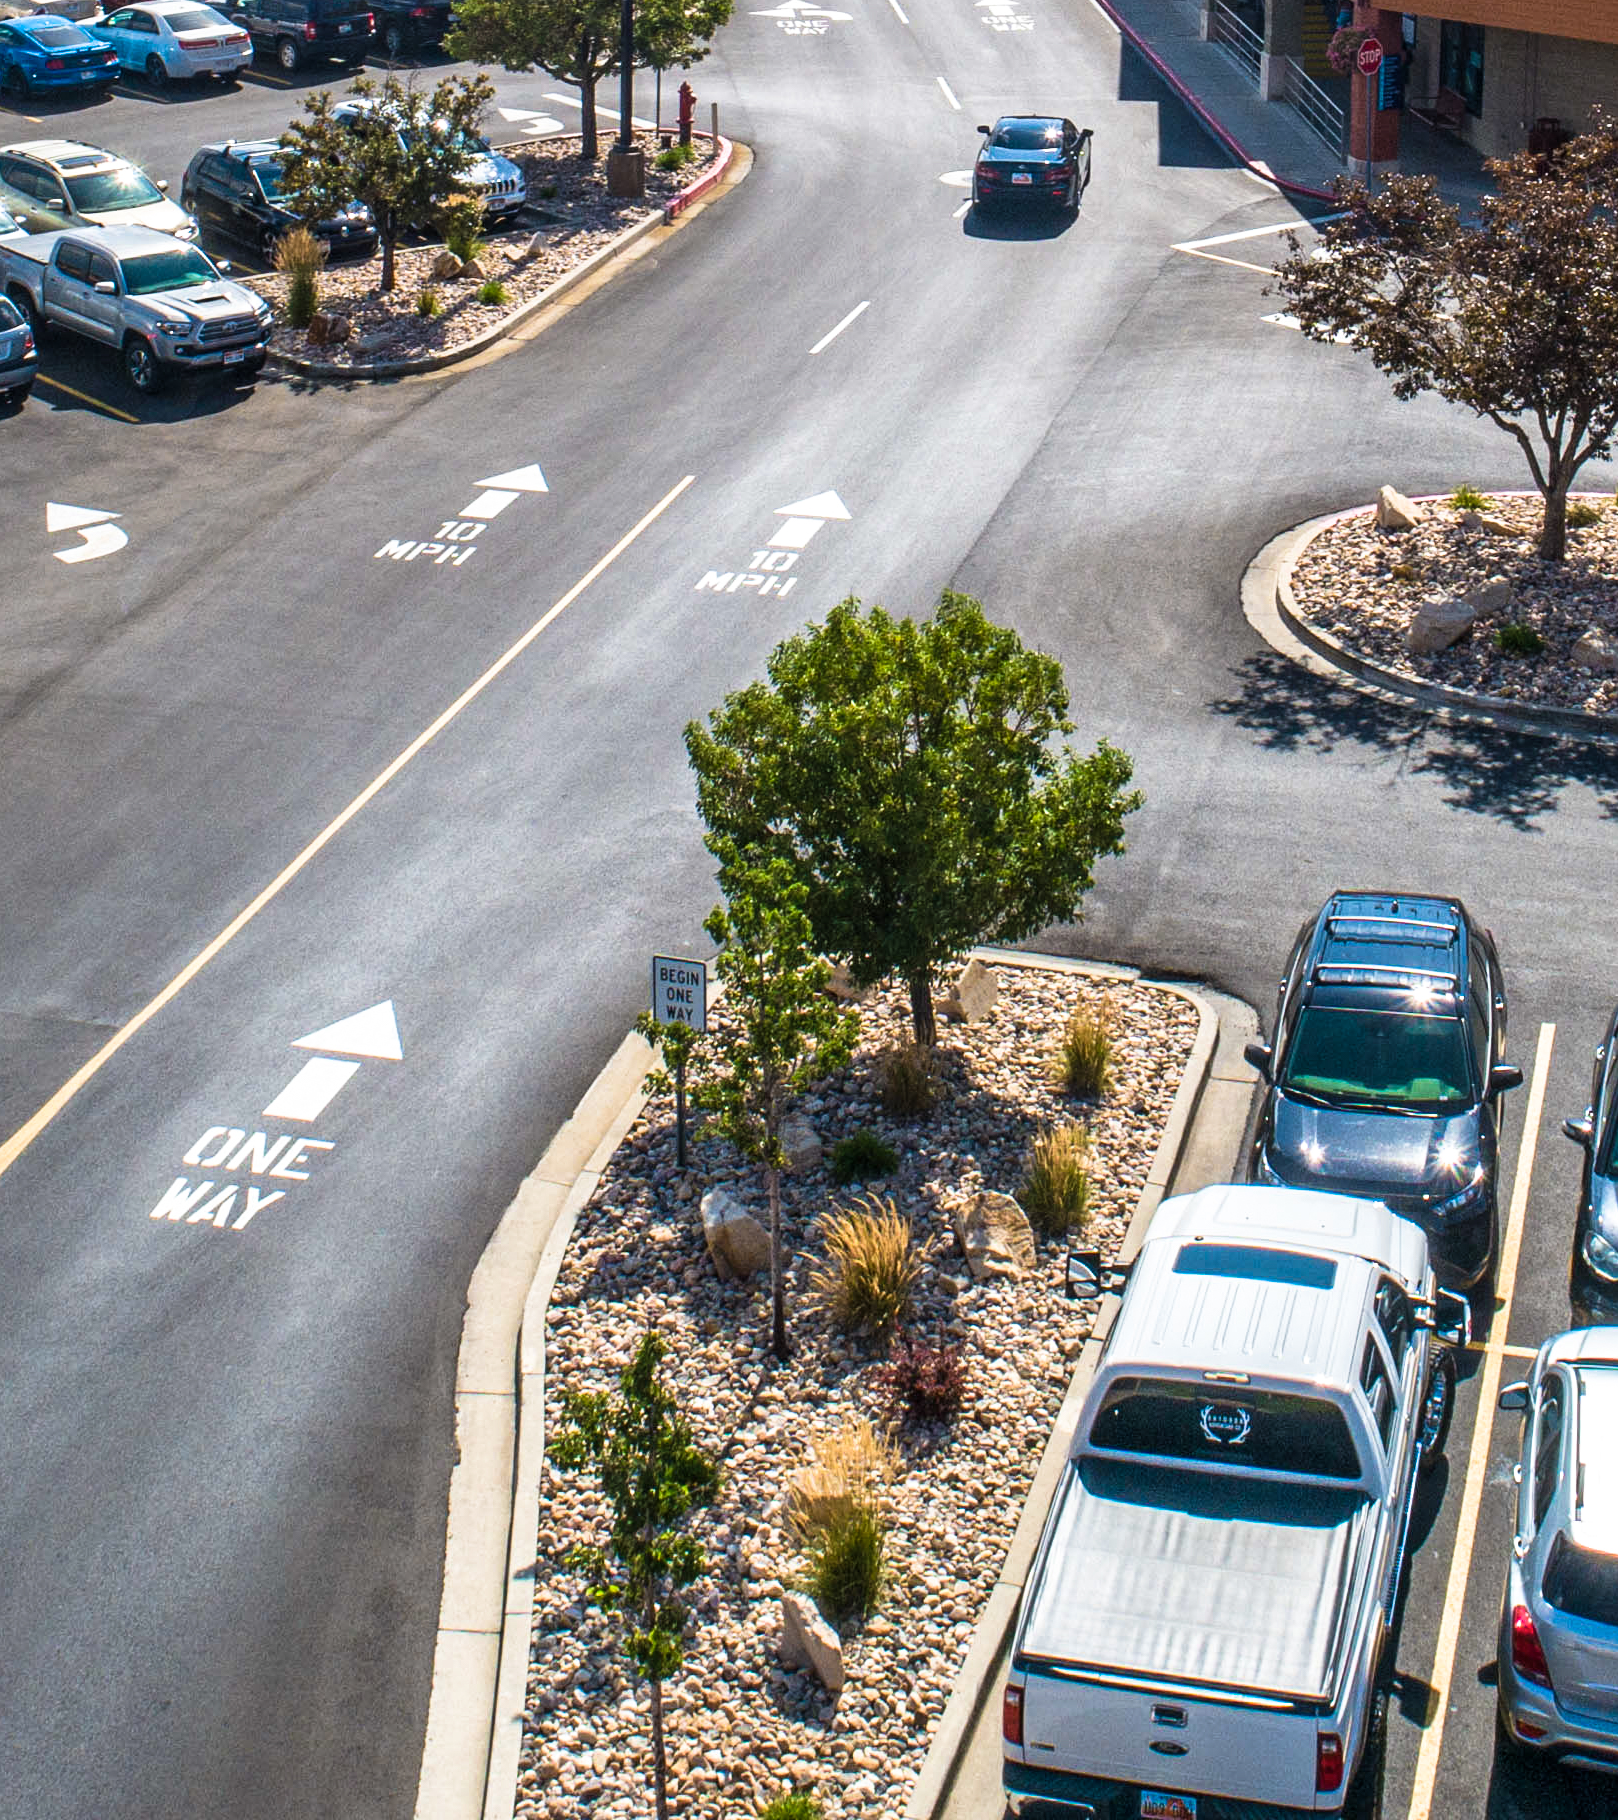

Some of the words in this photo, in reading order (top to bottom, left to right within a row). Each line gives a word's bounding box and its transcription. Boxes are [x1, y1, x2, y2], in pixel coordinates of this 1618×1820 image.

[776, 20, 830, 28] ONE
[784, 27, 828, 35] WAY
[1360, 48, 1381, 65] STOP
[434, 520, 487, 541] 10
[373, 539, 478, 566] MPH
[748, 550, 799, 572] 10
[693, 570, 798, 597] MPH
[660, 967, 700, 986] BEGIN
[667, 987, 694, 1003] ONE
[667, 1004, 694, 1020] WAY
[183, 1125, 336, 1181] ONE
[149, 1176, 286, 1231] WAY
